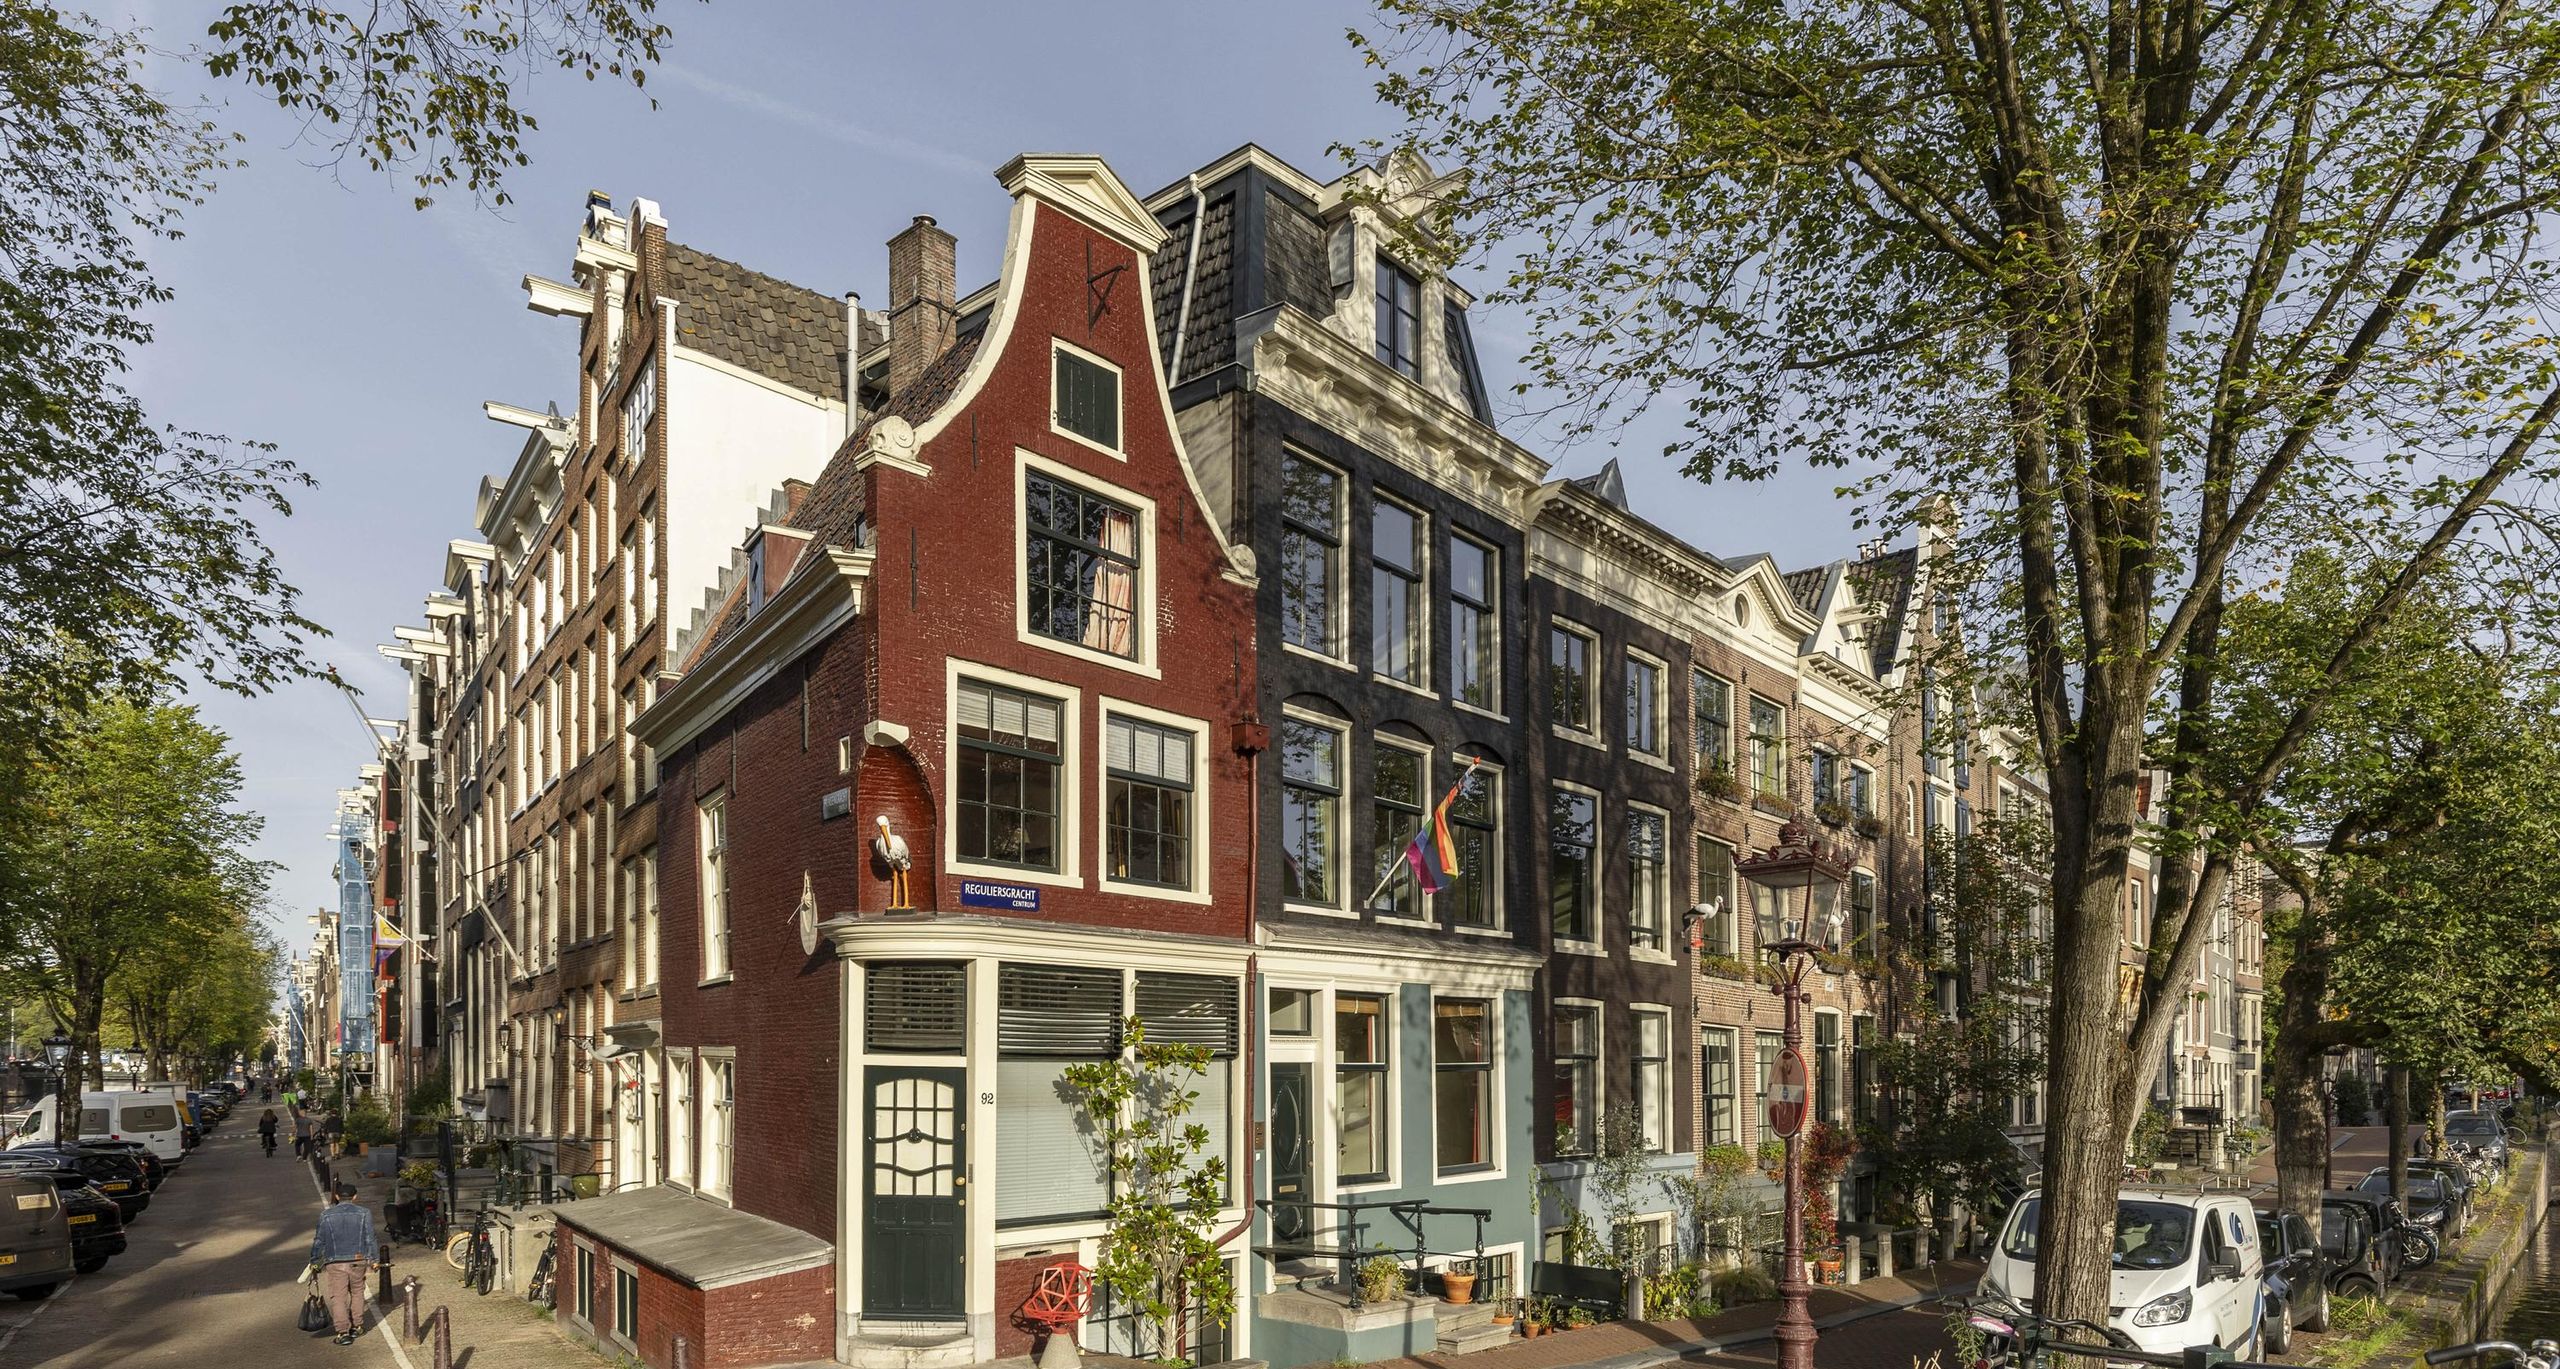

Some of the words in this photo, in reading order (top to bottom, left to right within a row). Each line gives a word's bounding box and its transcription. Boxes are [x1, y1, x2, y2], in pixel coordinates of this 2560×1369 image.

[965, 883, 1036, 900] REGULIERSGRACHT
[1012, 900, 1036, 908] CENTRUM
[981, 1092, 994, 1105] 92
